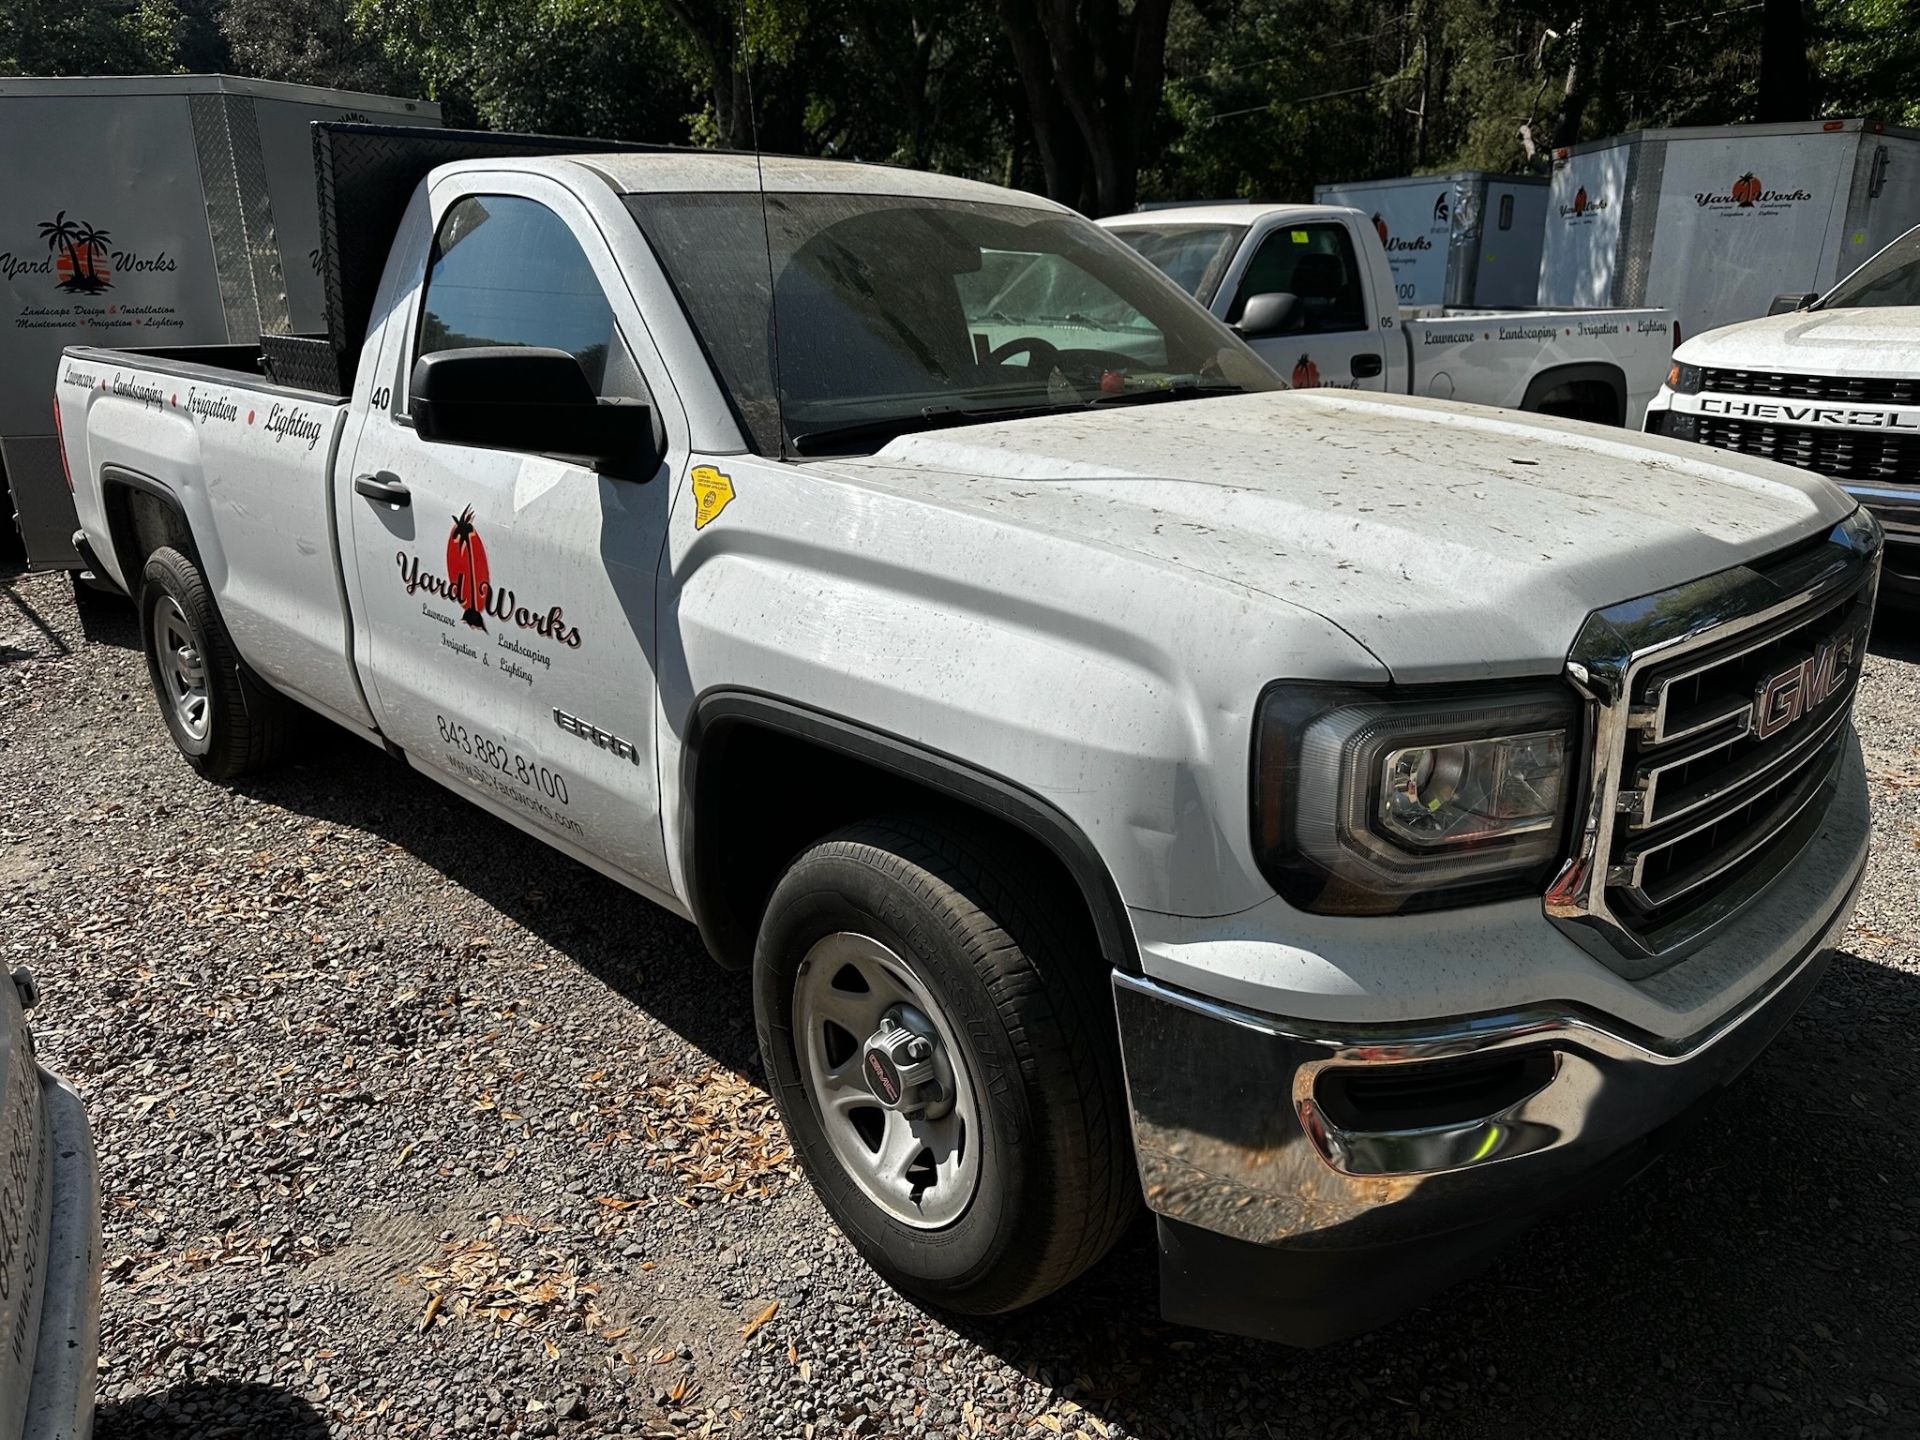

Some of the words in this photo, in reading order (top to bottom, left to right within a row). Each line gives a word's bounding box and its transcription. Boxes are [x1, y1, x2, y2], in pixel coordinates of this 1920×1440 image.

[1694, 191, 1742, 207] Yard
[1755, 189, 1811, 201] Works
[0, 252, 53, 281] Yard
[111, 251, 178, 273] Works
[15, 319, 77, 329] Maintenance
[87, 318, 133, 330] Irrigation
[144, 317, 184, 331] Lighting
[20, 305, 71, 316] Landscape
[73, 305, 106, 316] Design
[109, 305, 117, 315] &
[119, 304, 175, 315] Installation
[1424, 330, 1474, 345] Lawncare
[1498, 324, 1557, 343] Landscaping
[1577, 318, 1619, 338] Irrigation
[1637, 317, 1667, 337] Lighting
[64, 363, 96, 390] Lawncare
[112, 372, 164, 412] Landscaping
[184, 386, 238, 424] Irrigation
[264, 403, 322, 450] Lighting
[371, 387, 390, 410] 40
[396, 551, 468, 607] Yard
[479, 582, 582, 650] Works
[422, 603, 456, 627] Lawncare
[498, 633, 551, 670] Landscaping
[440, 632, 477, 660] Irrigation
[500, 657, 533, 687] Lighting
[1757, 637, 1854, 740] GMC
[437, 715, 569, 806] 843.882.8100
[869, 1054, 898, 1101] GMC
